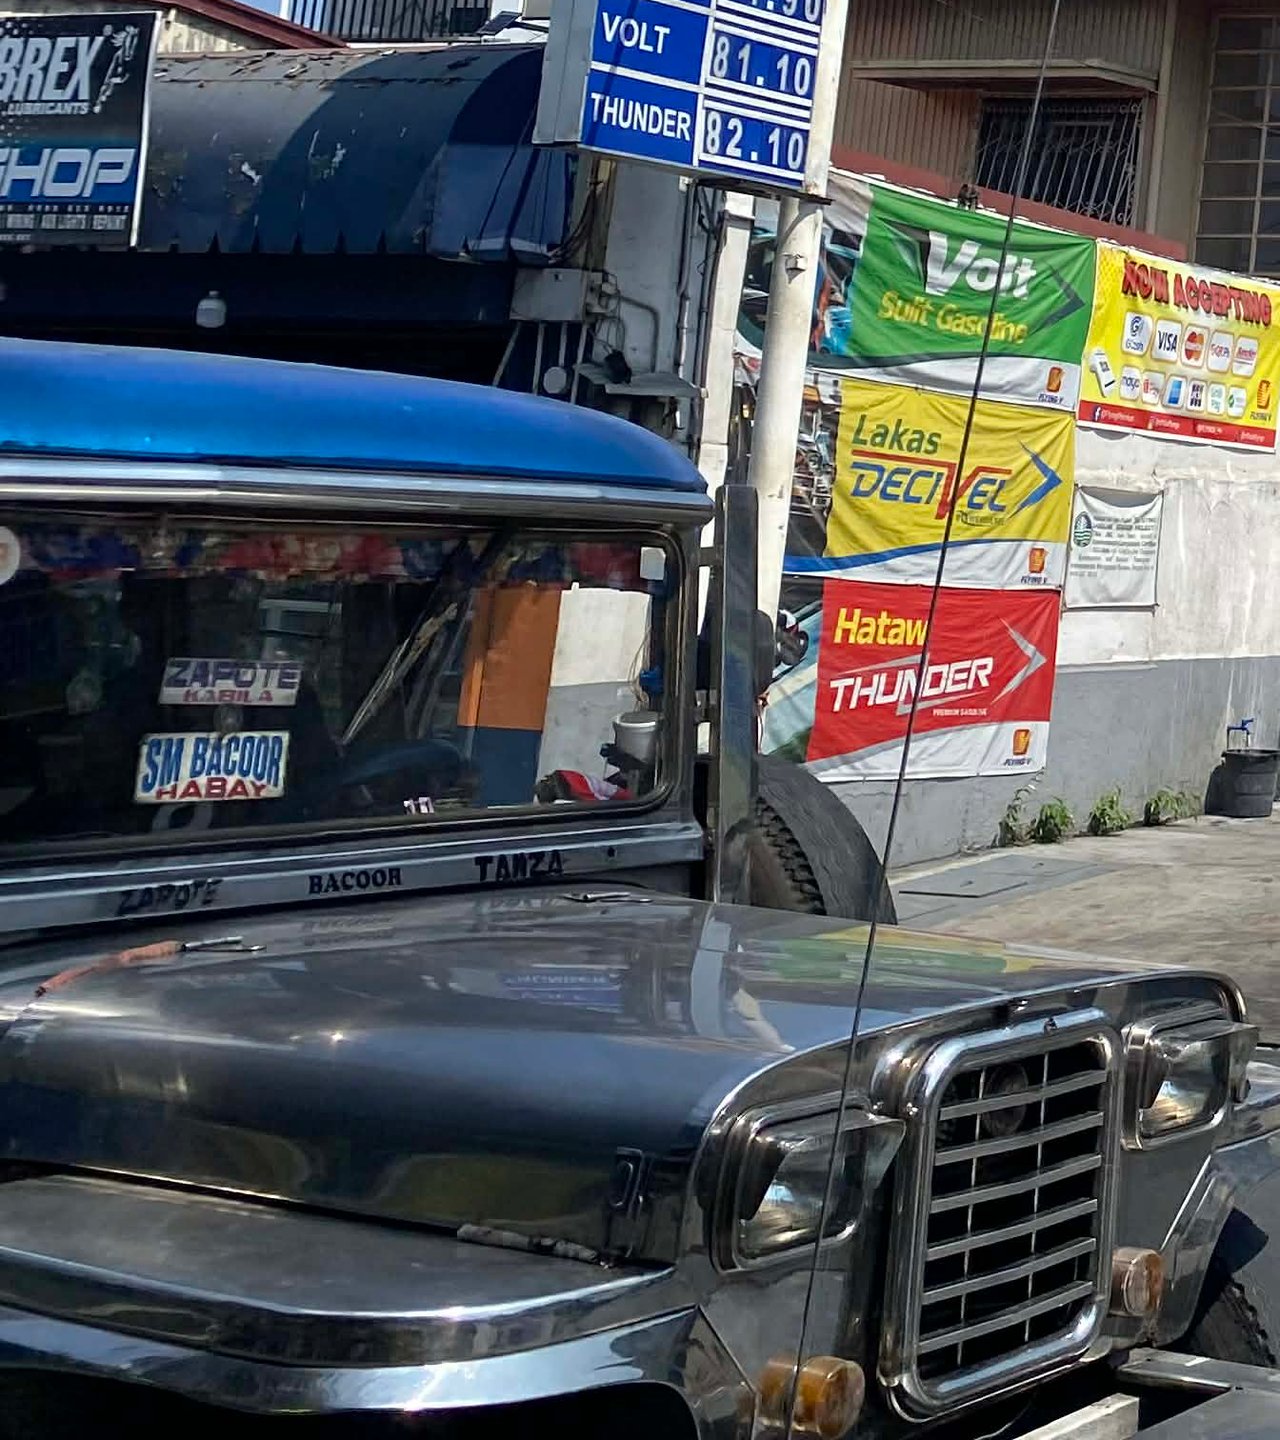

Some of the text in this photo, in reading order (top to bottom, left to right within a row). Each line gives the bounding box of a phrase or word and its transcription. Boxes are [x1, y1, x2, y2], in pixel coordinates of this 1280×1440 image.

[602, 12, 811, 96] VOLT 81.10
[7, 102, 89, 115] LUBRICANTS
[591, 93, 804, 170] THUNDER 82.10
[925, 230, 1036, 300] Volt
[1122, 258, 1272, 328] NOW ACCEPTING
[878, 290, 932, 328] Sulit
[1158, 331, 1178, 352] VISA
[851, 414, 942, 456] Lakas
[850, 455, 1012, 520] DECIVEL
[833, 607, 930, 648] Hataw
[164, 660, 300, 689] ZAPOTE
[829, 656, 993, 713] THUNDER
[141, 734, 283, 793] SM BACOOR
[156, 777, 266, 800] HABAY
[117, 849, 566, 915] ZAPOTE BACOOR TANZA
